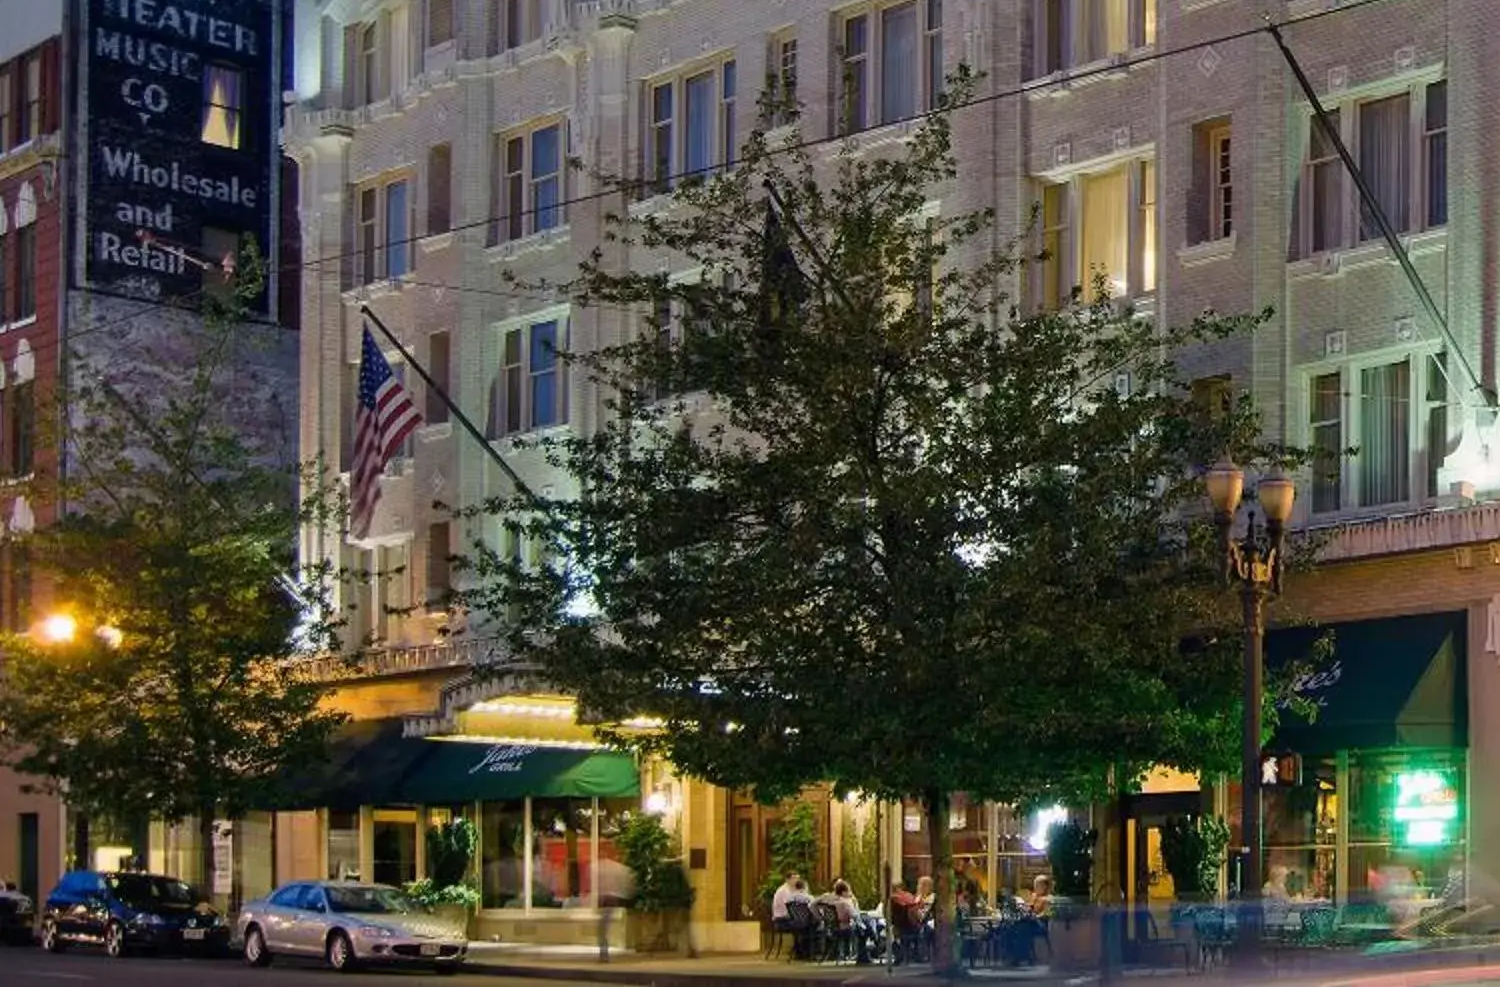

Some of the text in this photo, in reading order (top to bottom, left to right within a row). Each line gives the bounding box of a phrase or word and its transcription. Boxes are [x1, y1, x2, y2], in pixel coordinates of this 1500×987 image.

[96, 27, 200, 81] MUSIC
[102, 146, 257, 208] Wholesale
[116, 201, 173, 232] and
[100, 232, 186, 275] Retail
